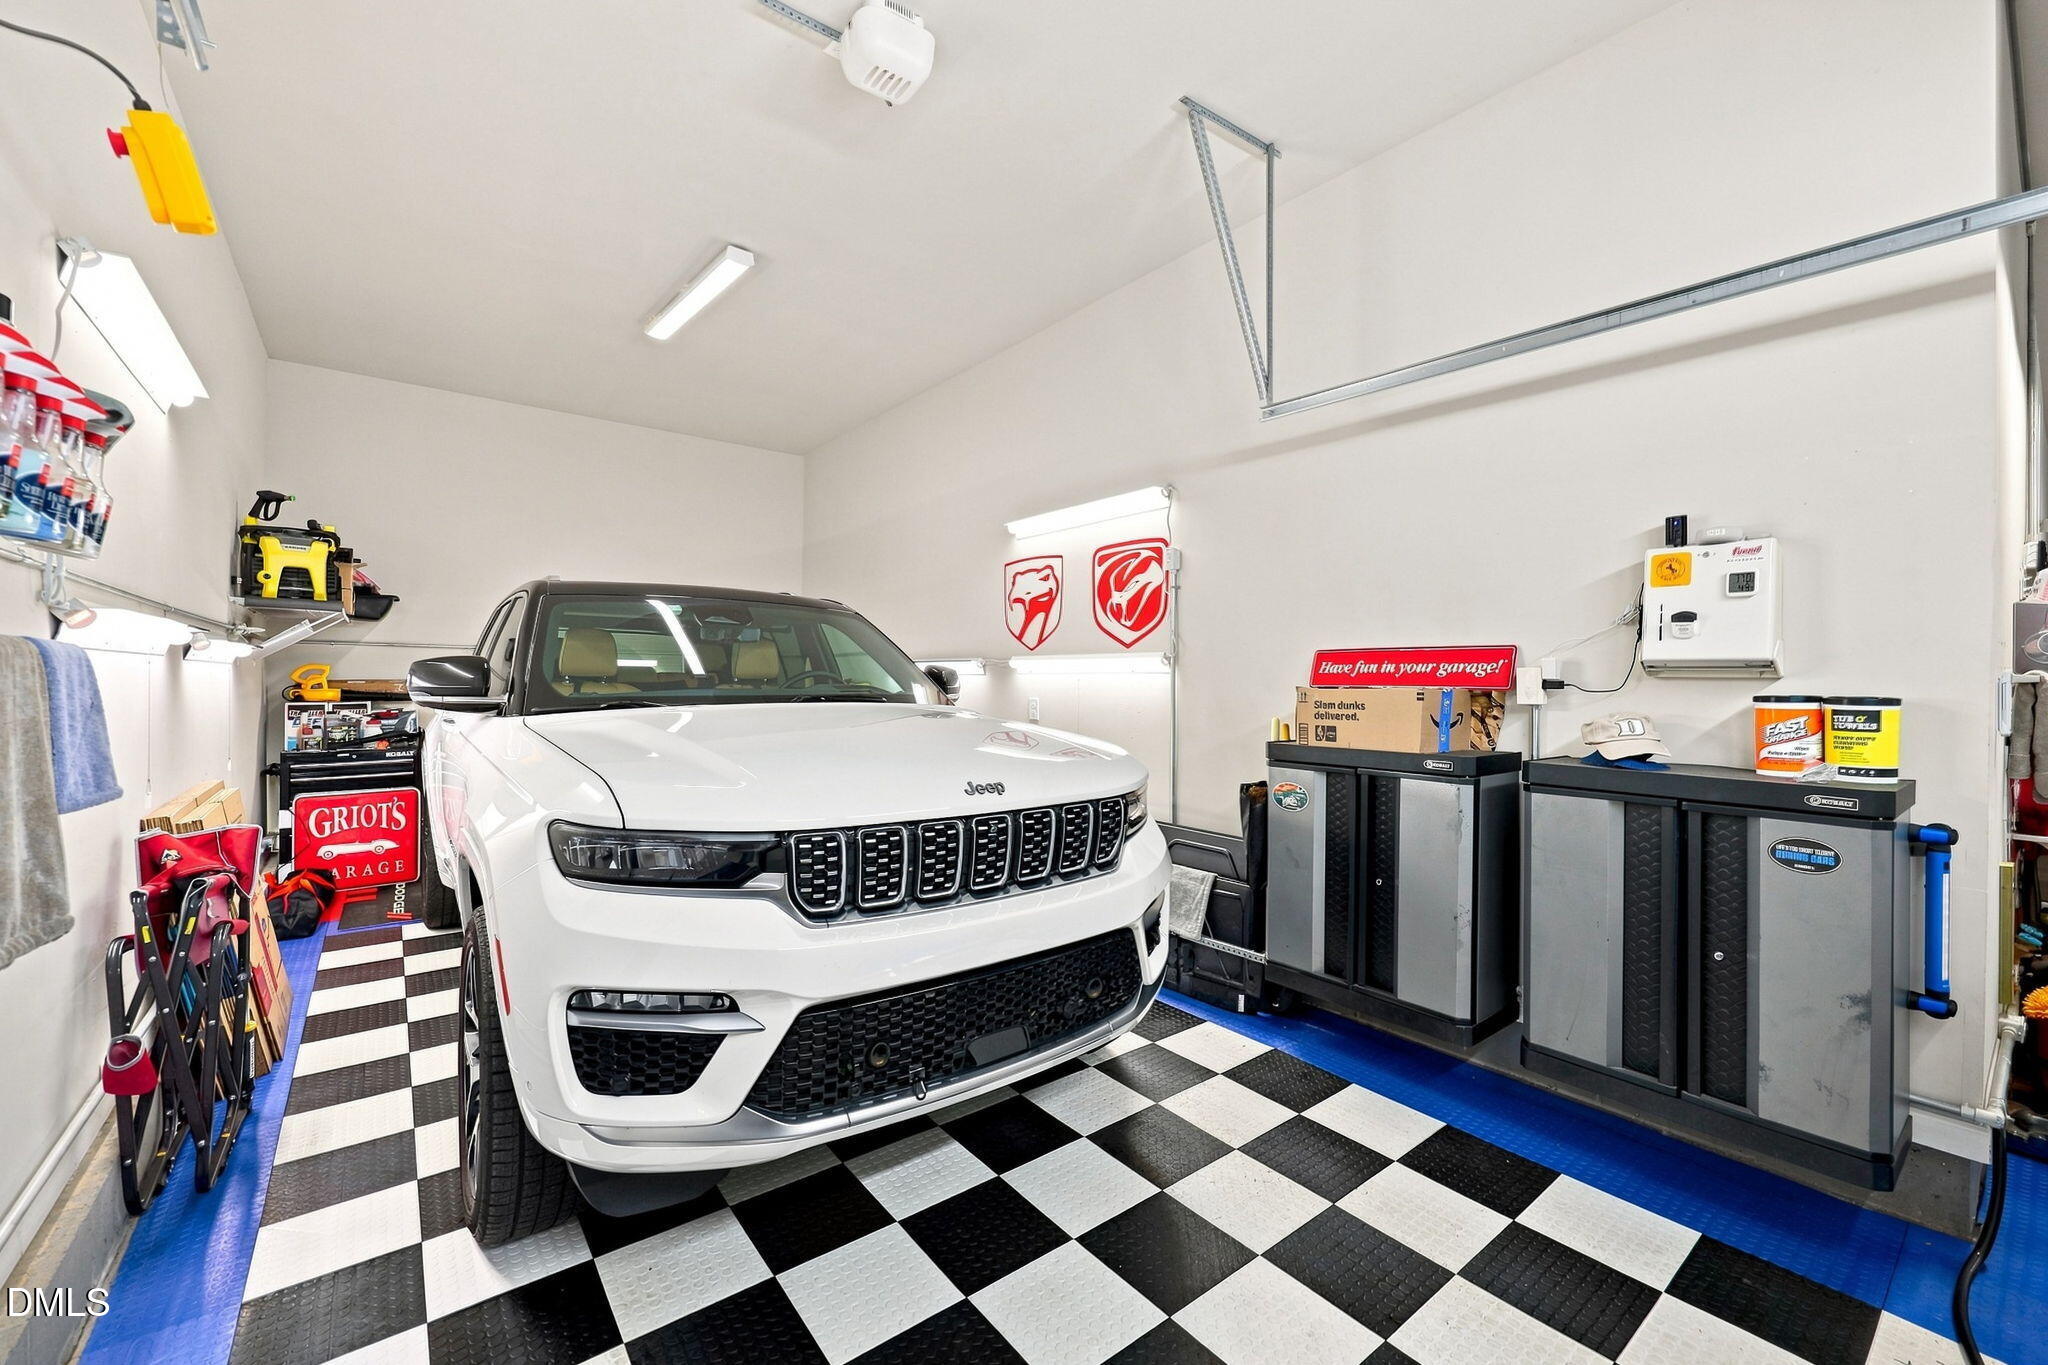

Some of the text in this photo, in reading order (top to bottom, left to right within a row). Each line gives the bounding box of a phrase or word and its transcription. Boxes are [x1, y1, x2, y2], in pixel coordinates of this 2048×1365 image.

[1318, 659, 1504, 678] Have fun in your garage!
[1314, 700, 1366, 710] Slam dunks
[1314, 711, 1360, 721] delivered.
[1763, 715, 1809, 738] FAST
[964, 781, 1006, 796] Jeep
[308, 796, 407, 838] GRIOT'S
[331, 860, 406, 880] ARAGE
[393, 883, 406, 915] DODGE
